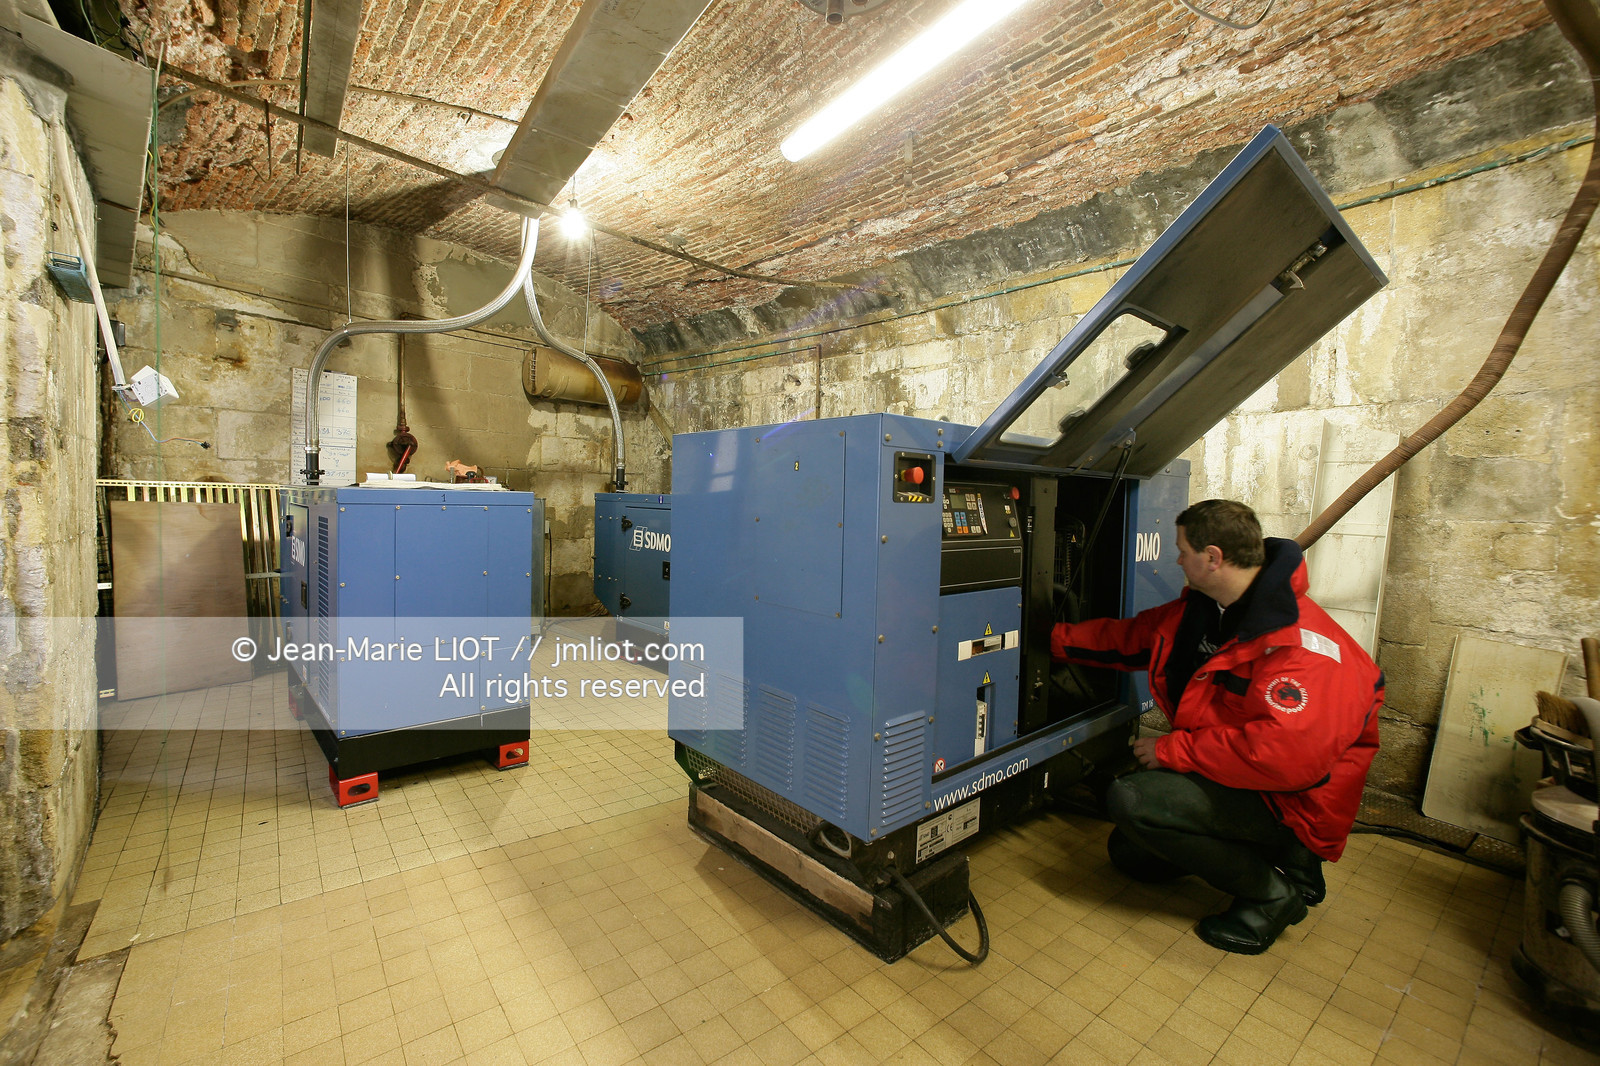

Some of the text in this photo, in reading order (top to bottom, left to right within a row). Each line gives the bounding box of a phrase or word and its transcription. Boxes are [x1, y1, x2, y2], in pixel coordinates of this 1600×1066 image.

[645, 531, 671, 552] SDMO
[1136, 532, 1160, 562] DMO
[934, 758, 1029, 812] www.sdmo.com
